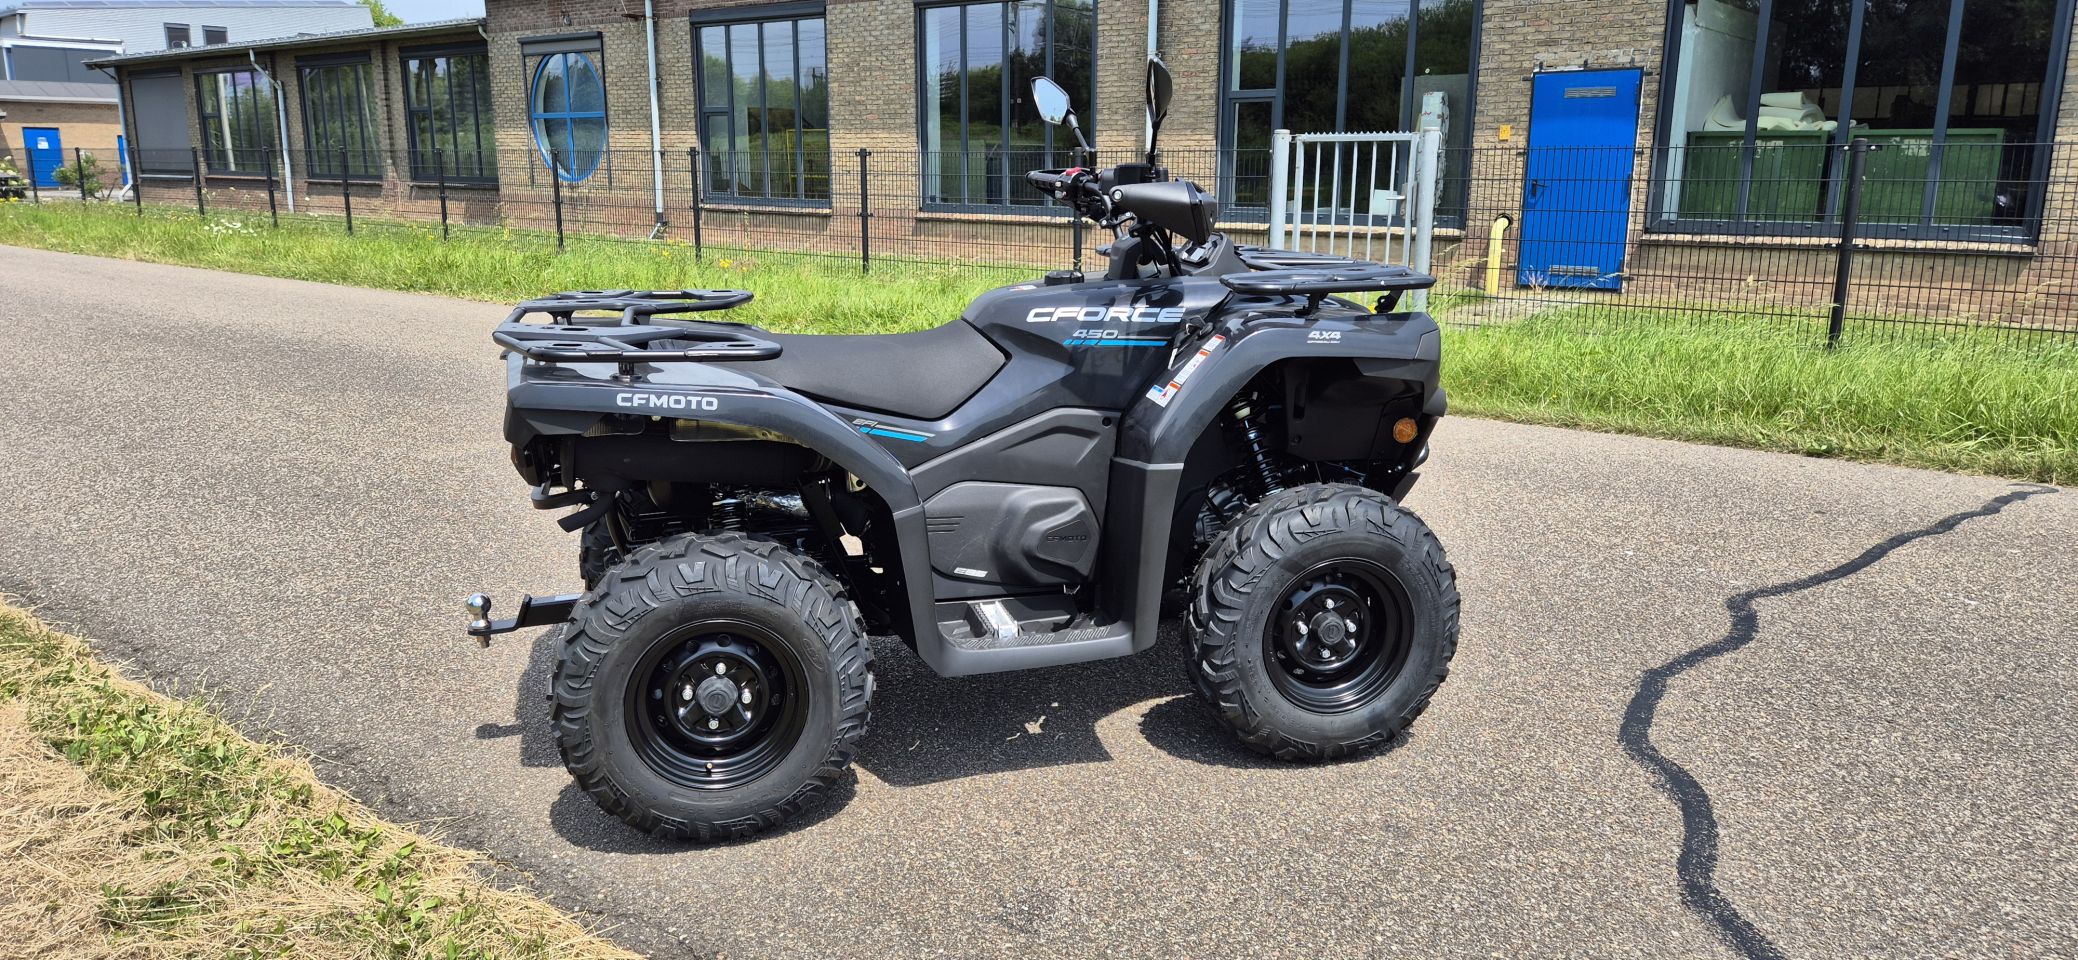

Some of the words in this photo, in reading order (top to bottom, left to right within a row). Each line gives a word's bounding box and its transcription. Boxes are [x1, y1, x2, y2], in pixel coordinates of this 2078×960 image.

[1026, 307, 1185, 323] CFORCE
[1072, 329, 1119, 339] 450
[1308, 330, 1342, 339] 4X4
[616, 392, 719, 411] CFMOTO
